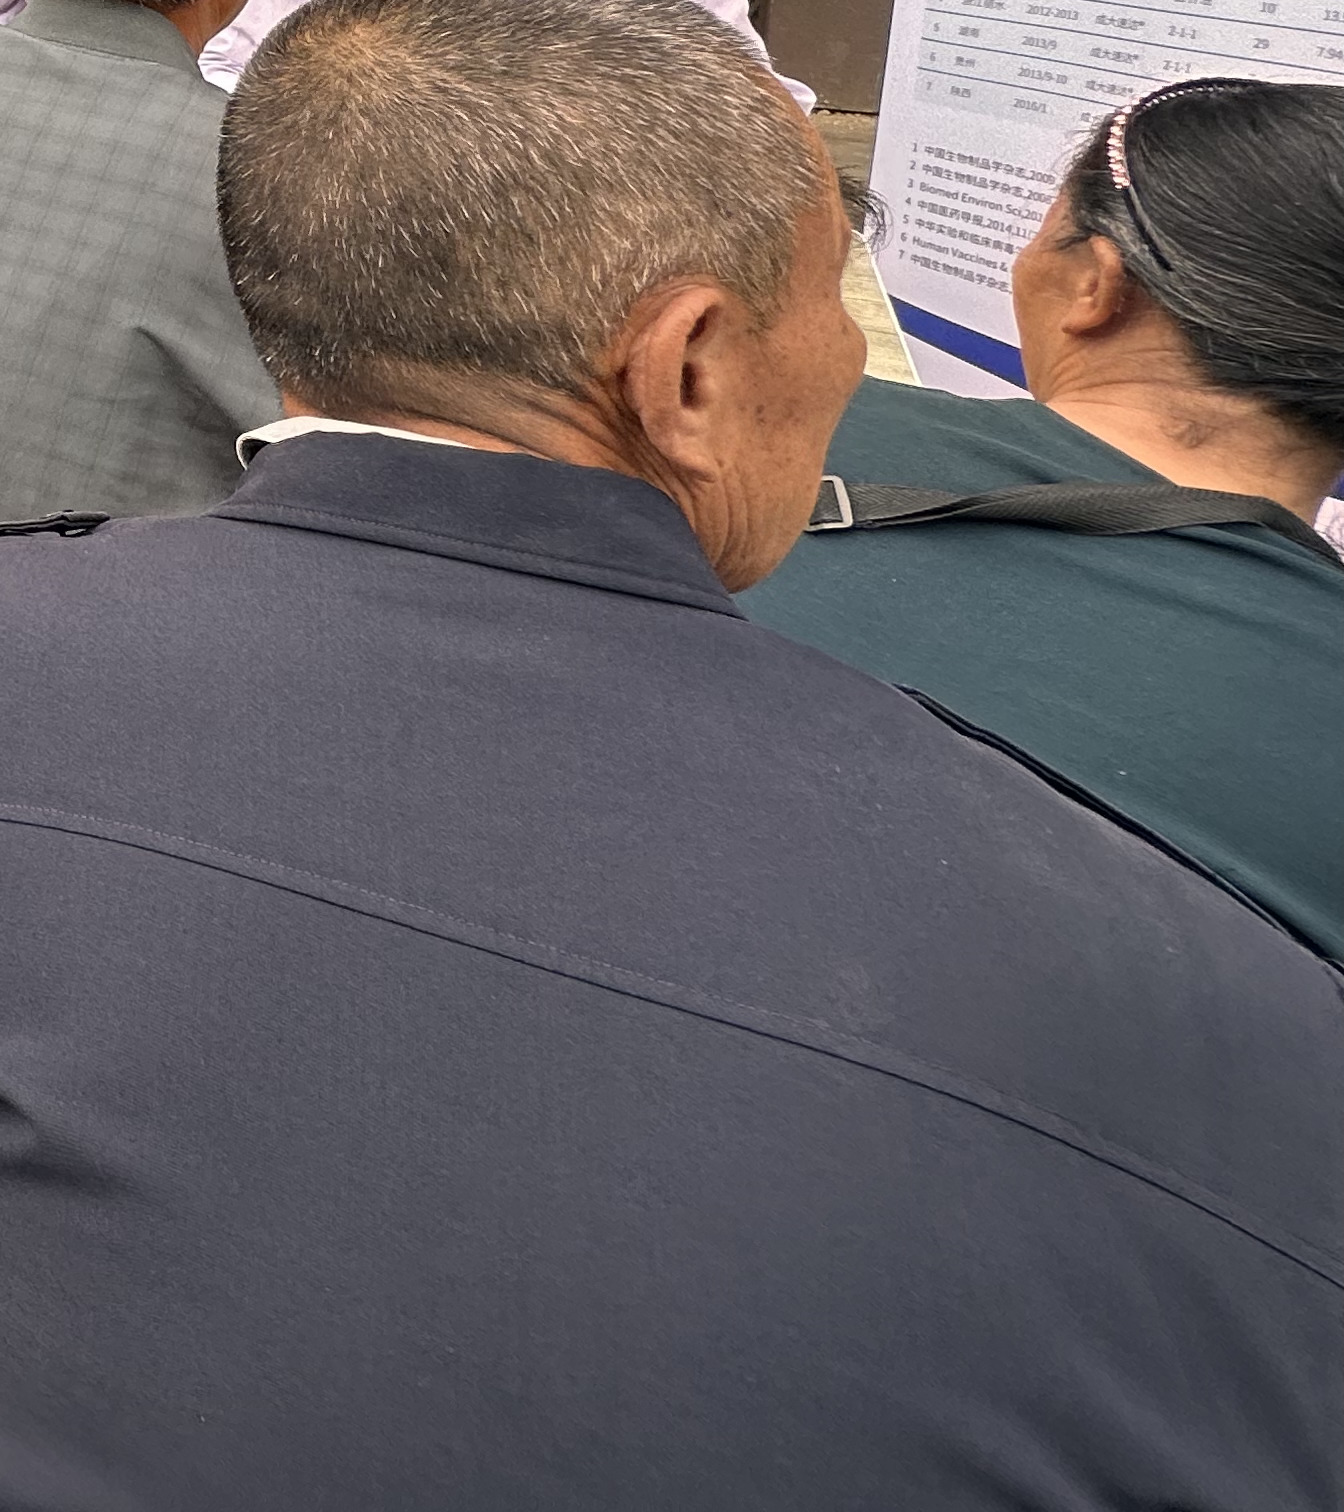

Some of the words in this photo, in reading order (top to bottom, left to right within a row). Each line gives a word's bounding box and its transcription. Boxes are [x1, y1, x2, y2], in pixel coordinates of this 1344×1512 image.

[919, 182, 959, 201] Biomed
[962, 192, 1003, 212] Environ
[912, 236, 950, 255] Human
[950, 247, 998, 270] Vaccines
